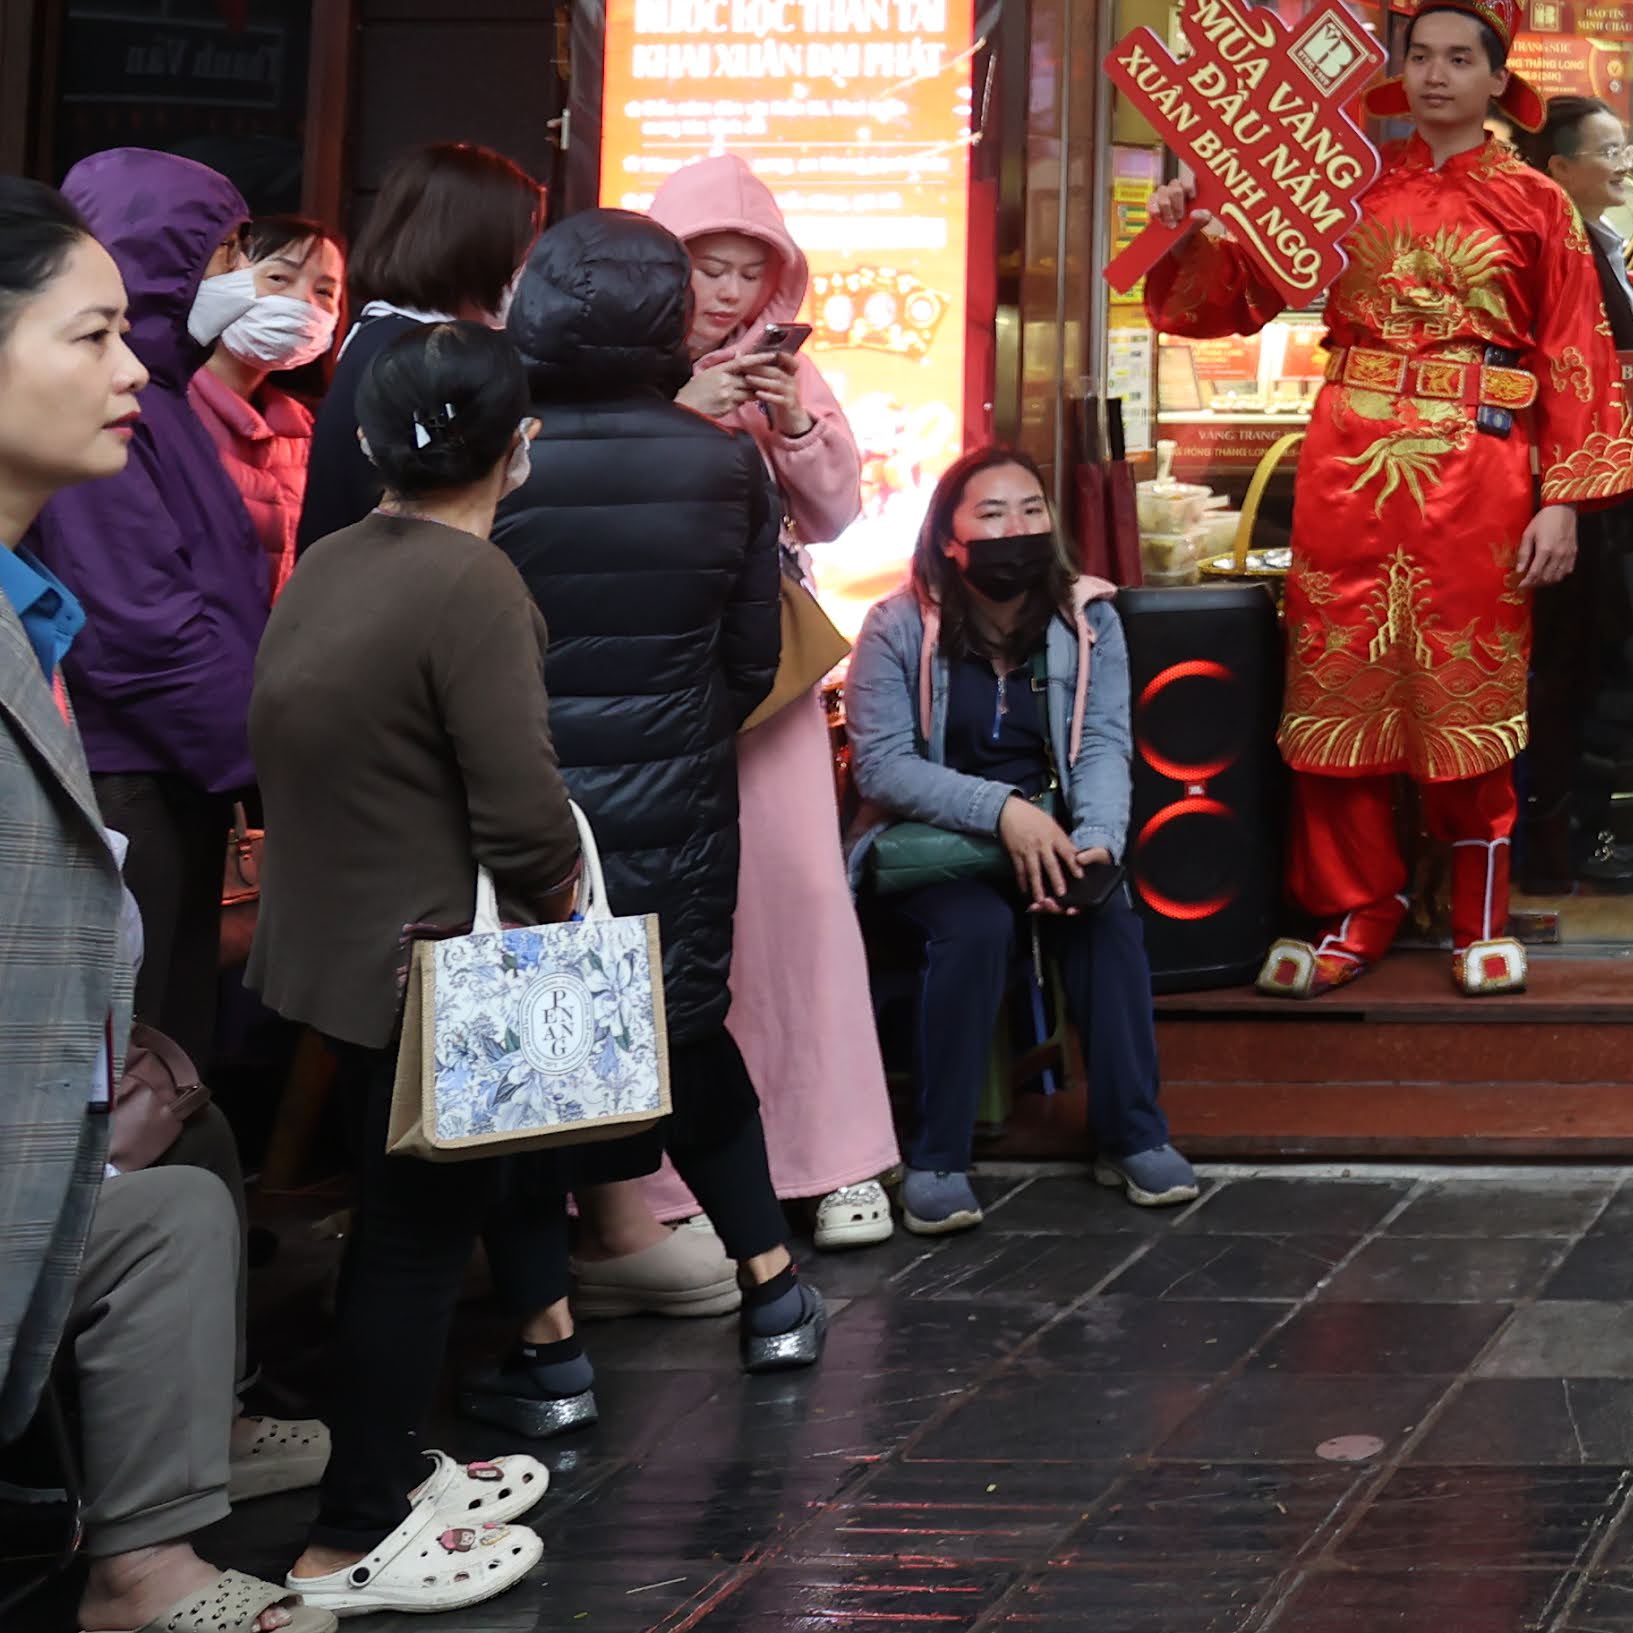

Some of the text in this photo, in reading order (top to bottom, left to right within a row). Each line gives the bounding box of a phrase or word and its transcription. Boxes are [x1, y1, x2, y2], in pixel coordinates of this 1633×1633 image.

[1117, 44, 1323, 278] XUÂN BÍNH NGỌ
[1258, 143, 1346, 235] NĂM
[1267, 81, 1363, 190] VÀNG
